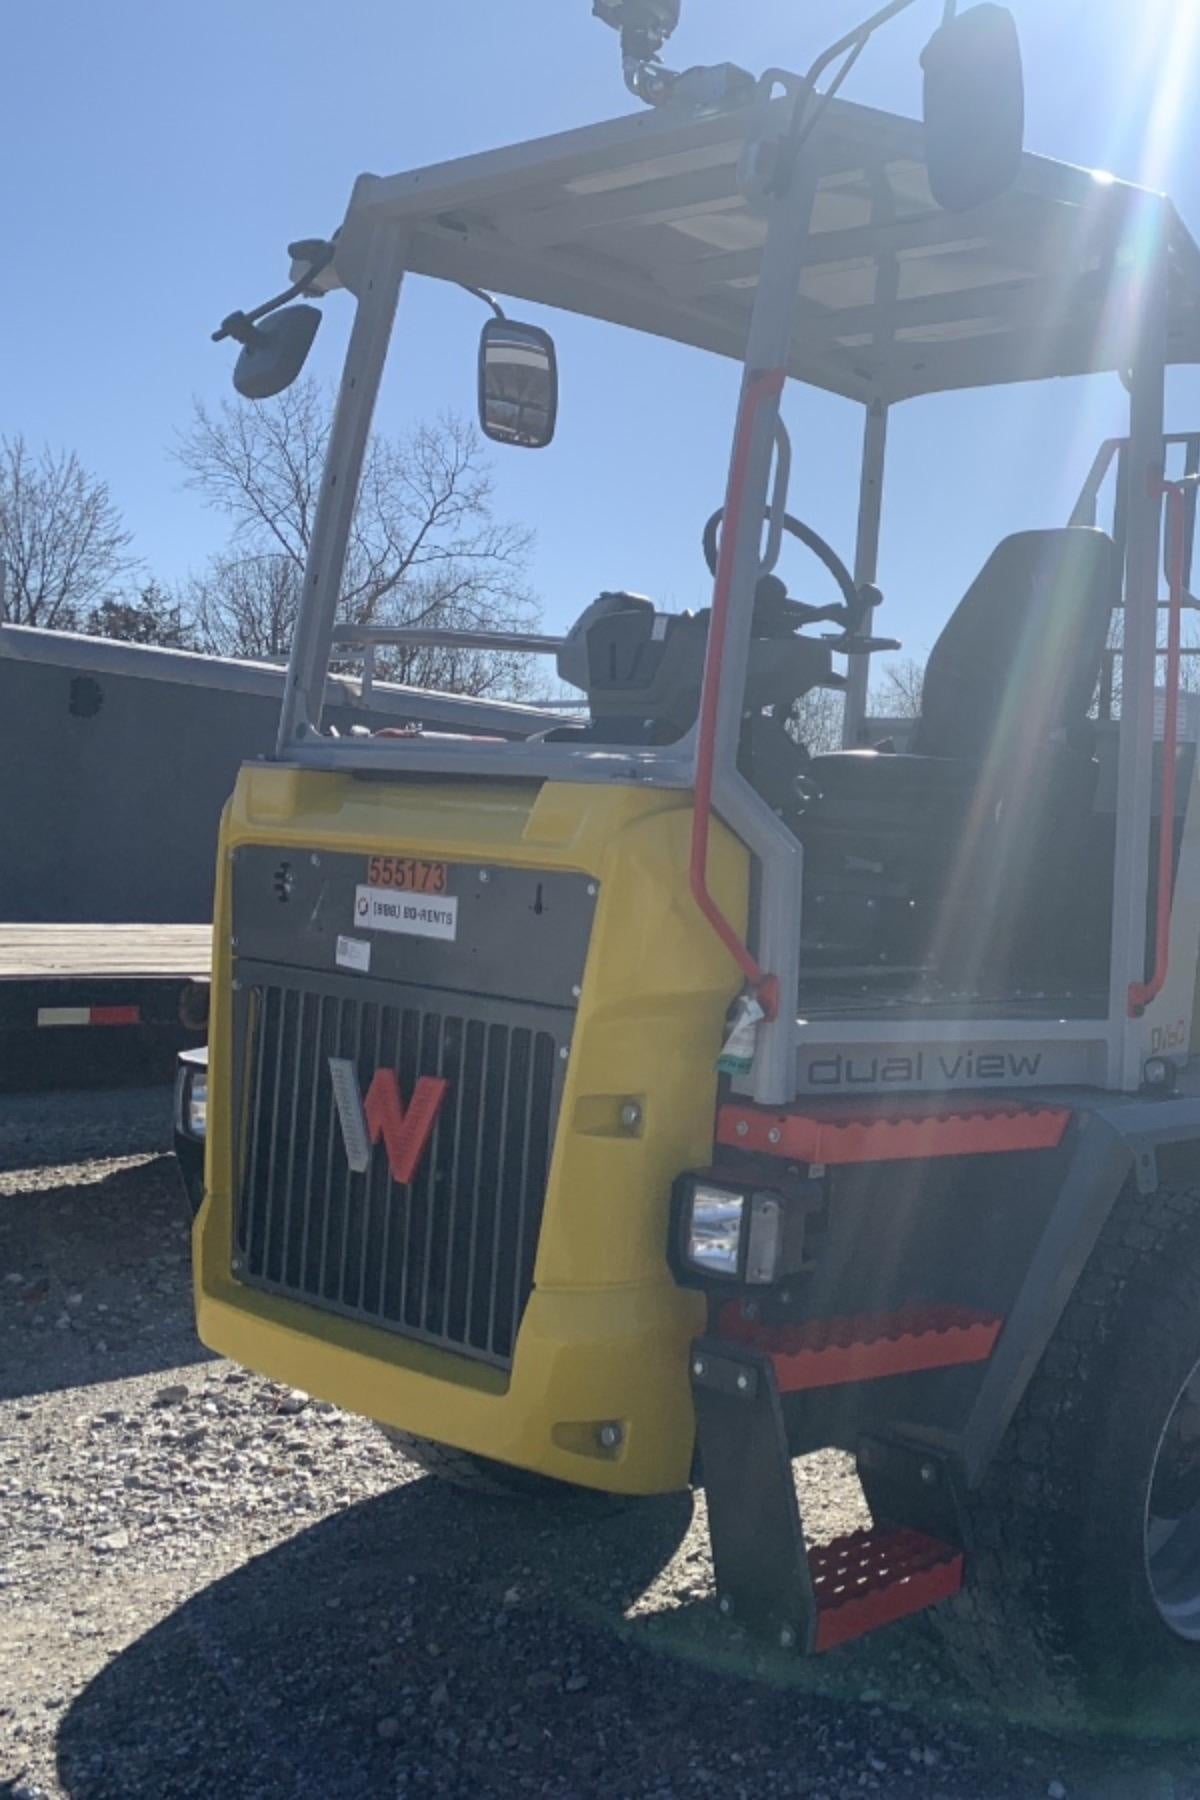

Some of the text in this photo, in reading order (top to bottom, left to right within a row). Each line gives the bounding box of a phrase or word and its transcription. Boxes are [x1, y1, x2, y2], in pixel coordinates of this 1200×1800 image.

[369, 856, 446, 891] 555173
[807, 1050, 1043, 1085] dual view
